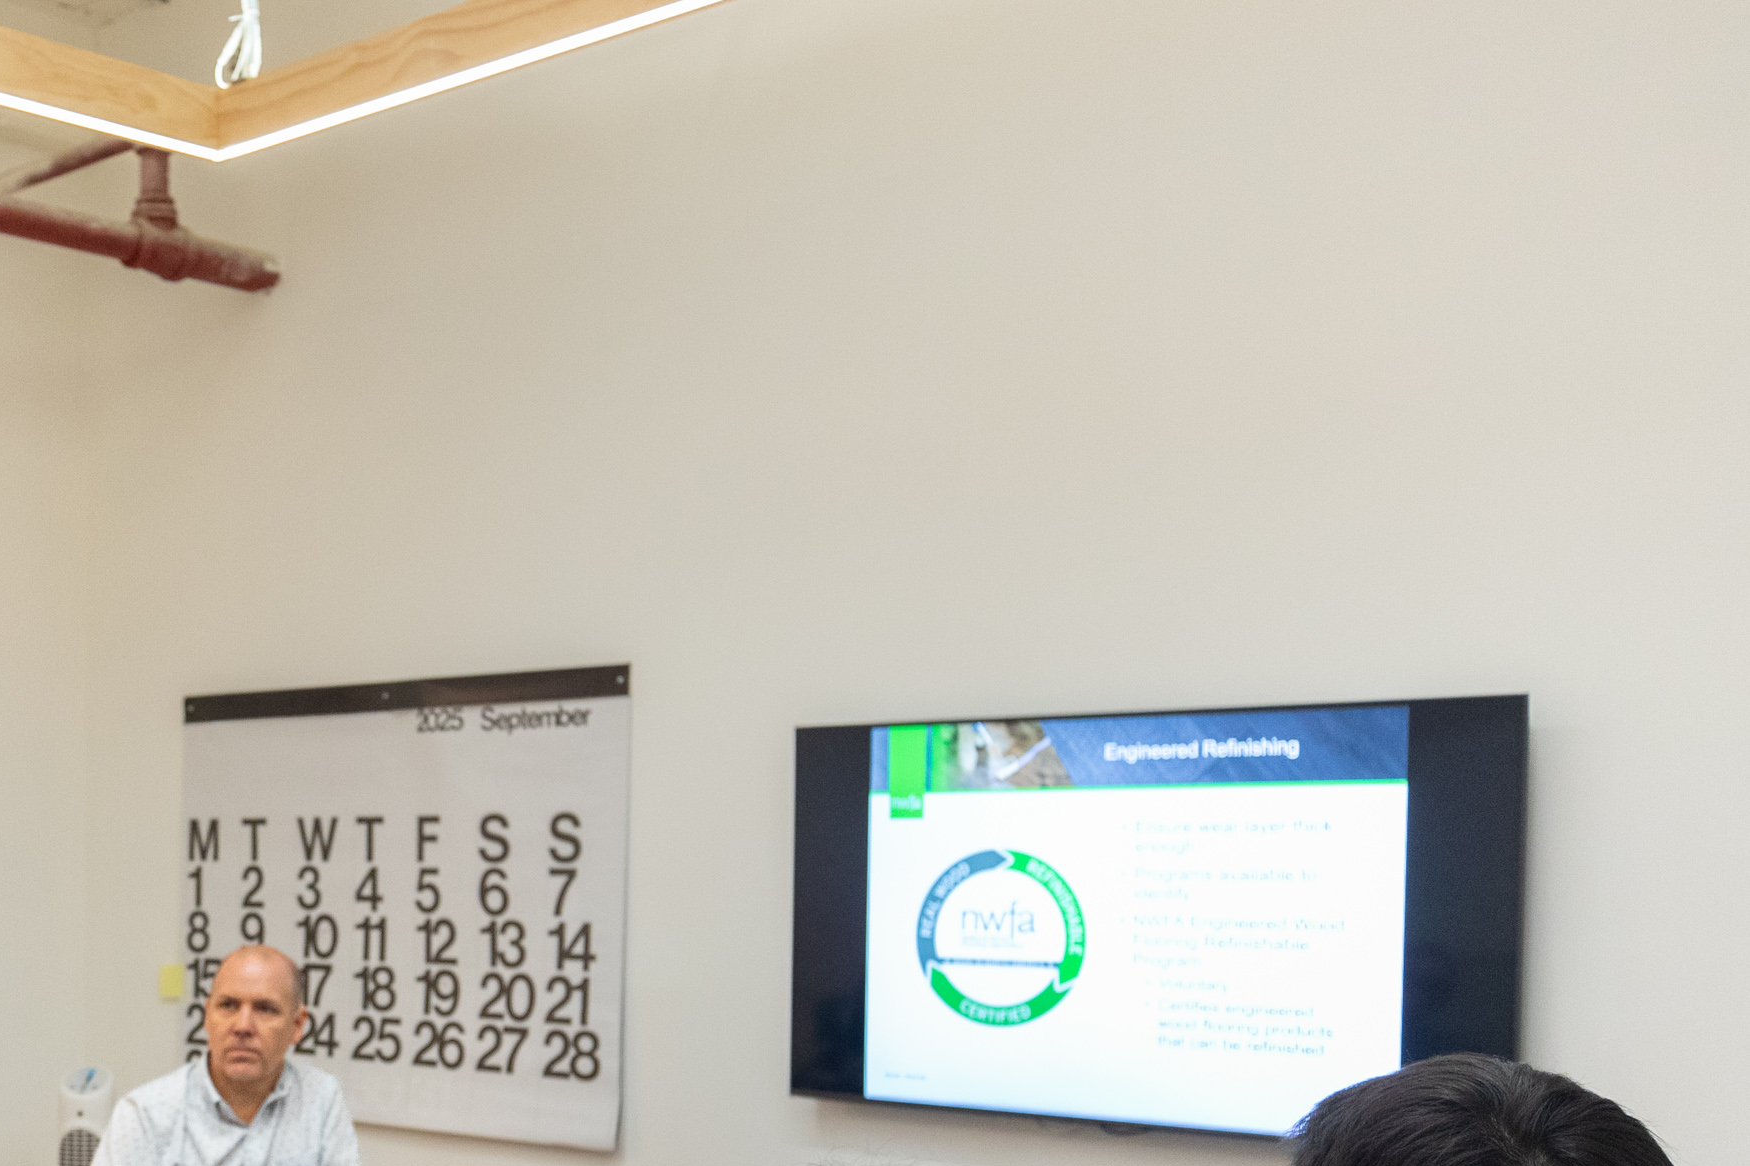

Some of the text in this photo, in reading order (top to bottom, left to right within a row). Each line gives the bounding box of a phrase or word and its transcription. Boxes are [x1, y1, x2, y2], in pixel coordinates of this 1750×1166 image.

[416, 706, 591, 735] 2025 September
[1103, 736, 1300, 764] Engineered Refinishing
[188, 812, 582, 864] M T W T F S S
[187, 865, 578, 917] 1 2 3 4 5 6 7
[187, 911, 596, 971] 8 9 10 11 12 13 14
[961, 900, 1035, 939] nwfa
[300, 963, 332, 1007] 17
[354, 966, 396, 1013] 18
[417, 969, 459, 1017] 19
[478, 973, 535, 1021] 20
[546, 976, 590, 1026] 21
[959, 998, 1032, 1024] CERTIFIED
[294, 1013, 339, 1057] 24
[353, 1016, 403, 1063] 25
[412, 1020, 466, 1070] 26
[475, 1026, 529, 1074] 27
[543, 1031, 601, 1081] 28
